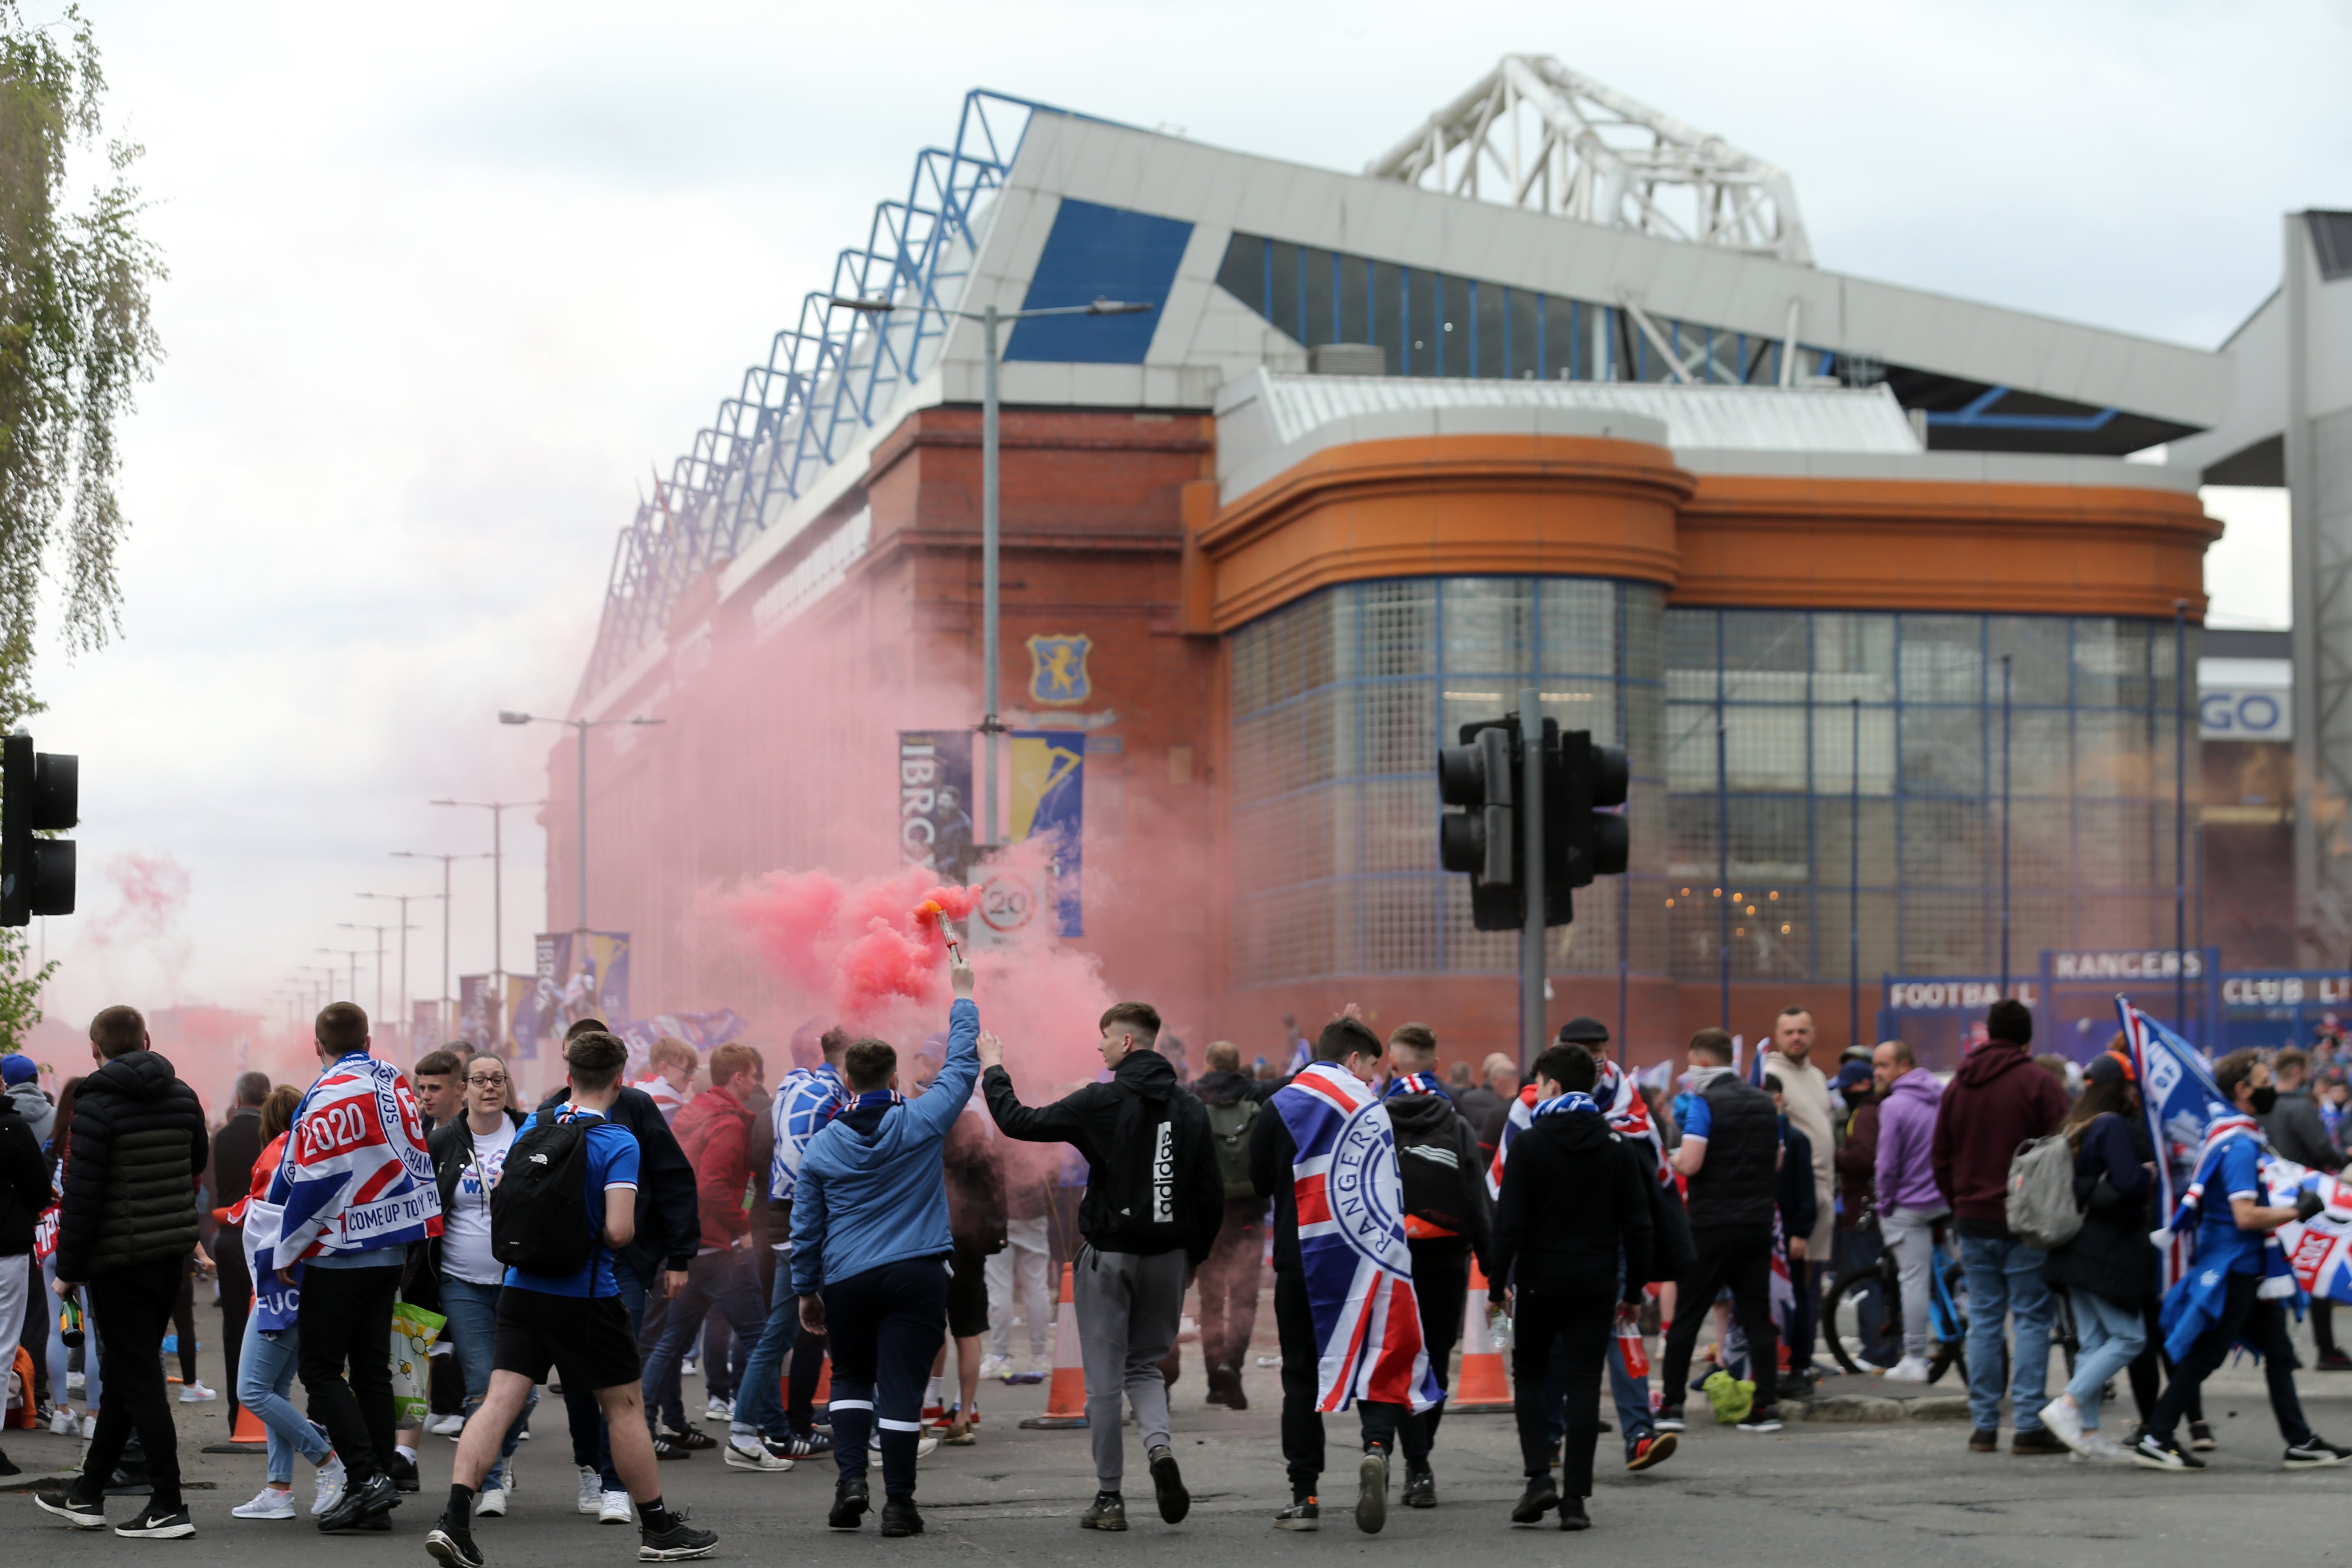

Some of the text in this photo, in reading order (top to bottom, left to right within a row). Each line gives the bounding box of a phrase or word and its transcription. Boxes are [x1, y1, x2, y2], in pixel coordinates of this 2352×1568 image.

[2201, 694, 2280, 731] GO
[989, 891, 1027, 914] 20
[2056, 951, 2202, 979] RANGERS
[1891, 982, 2038, 1008] FOOTBAL
[2223, 977, 2305, 1005] CLUB
[302, 1102, 366, 1158] 2020
[1154, 1130, 1173, 1215] adidas
[1338, 1114, 1393, 1254] RANGERS
[349, 1207, 383, 1231] COME
[385, 1203, 400, 1223] UP
